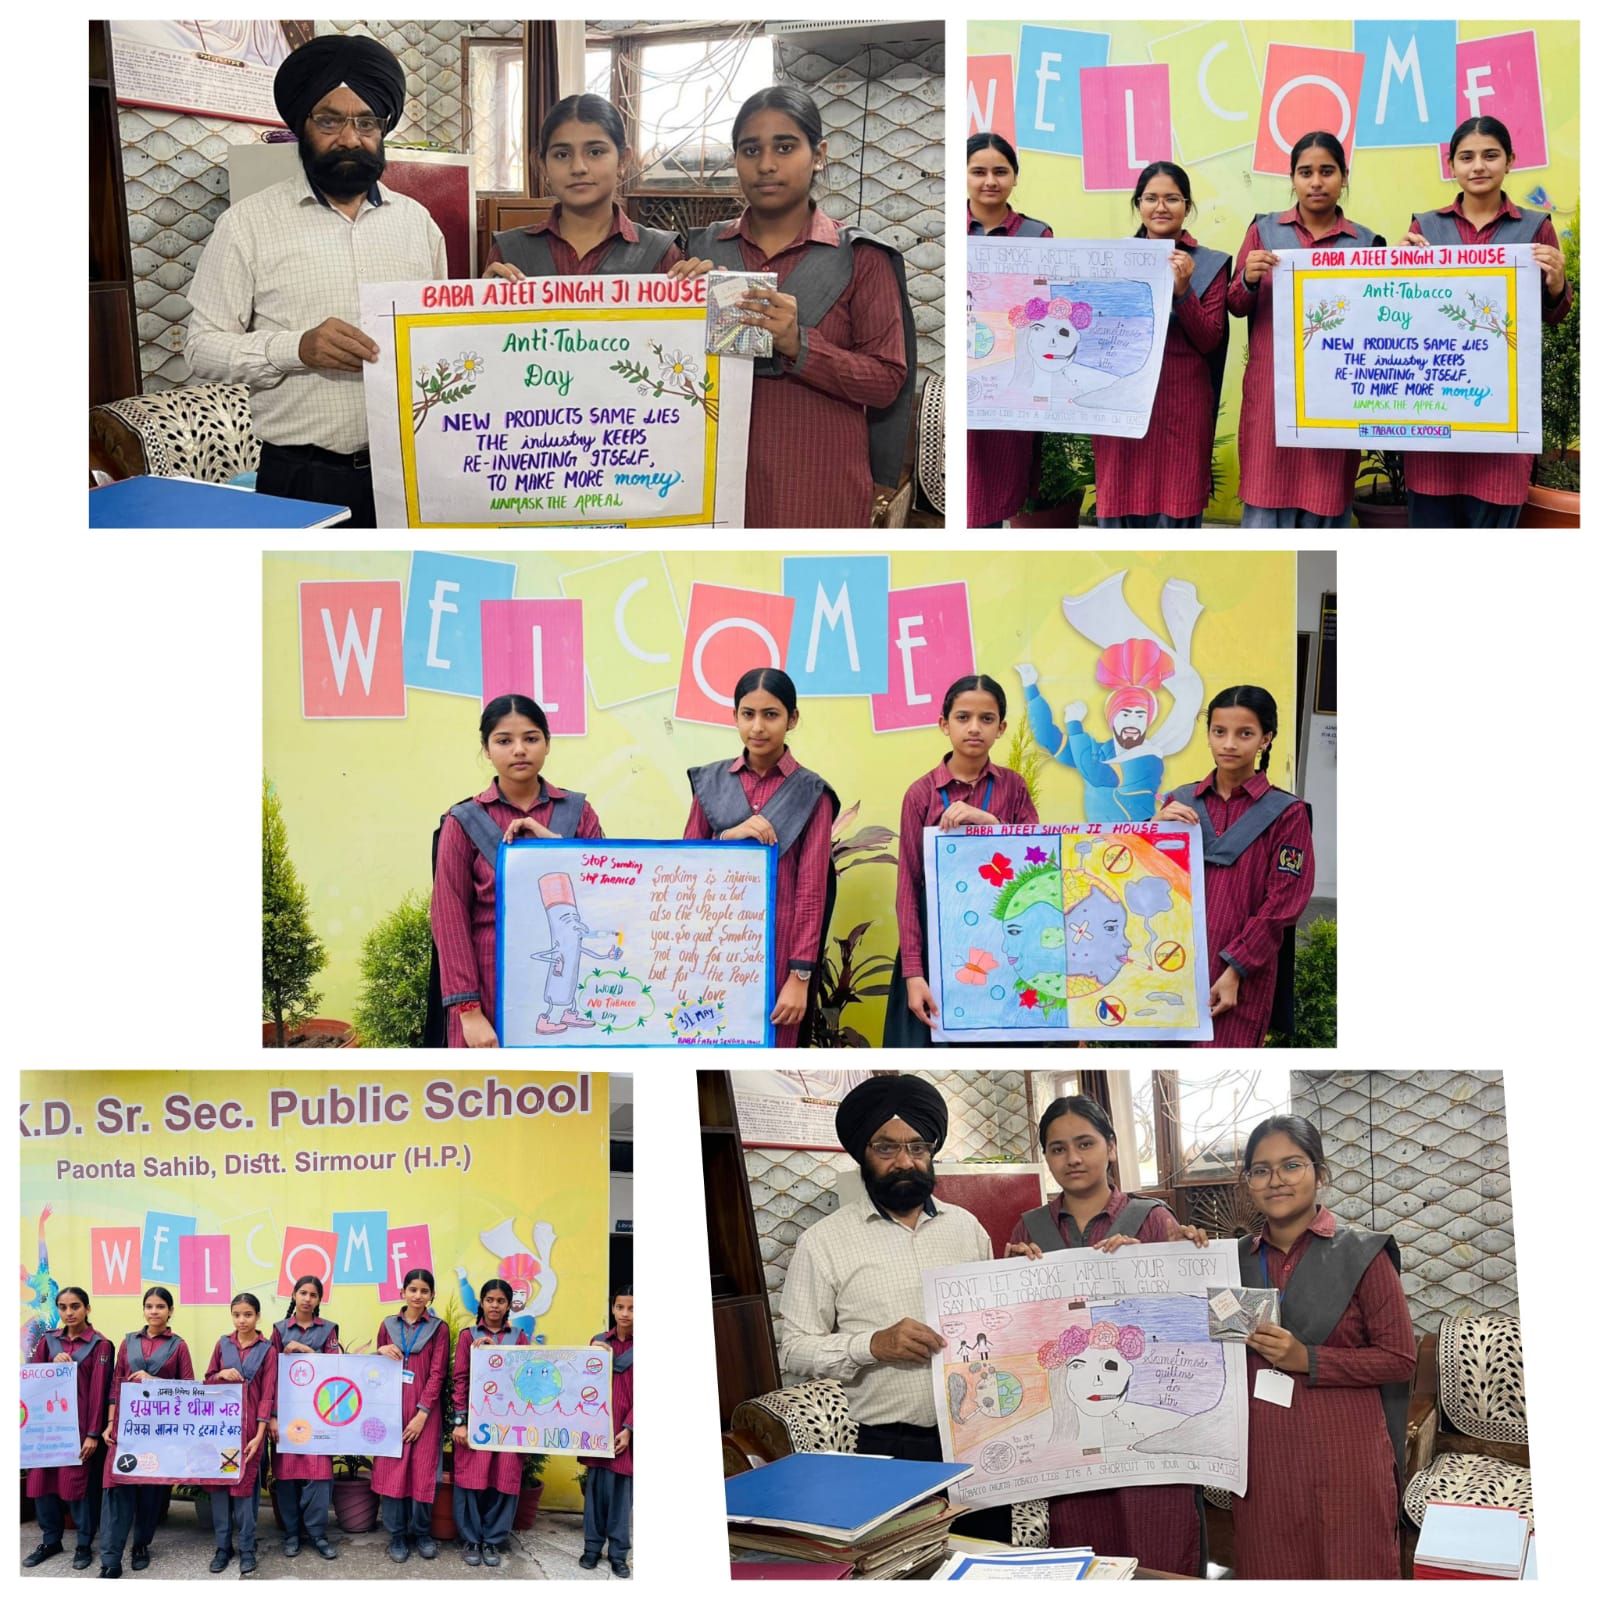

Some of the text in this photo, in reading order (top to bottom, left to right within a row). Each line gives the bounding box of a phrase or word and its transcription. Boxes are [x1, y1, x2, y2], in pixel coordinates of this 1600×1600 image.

[1040, 250, 1076, 265] WRITE
[1088, 251, 1113, 267] YOUR
[1123, 252, 1157, 267] STORY
[1312, 248, 1506, 266] BABA AJEET SINGH JI HOUSE
[422, 284, 474, 308] BABA
[483, 281, 537, 305] AJEET
[542, 279, 604, 304] SINGH
[611, 279, 630, 303] JI
[638, 279, 706, 303] HOUSE
[1377, 306, 1413, 330] Day
[1321, 337, 1488, 351] NEW PRODUCTS SAME LIES
[1344, 353, 1465, 370] THE industry KEEPS
[524, 363, 574, 396] Day
[1335, 367, 1416, 381] RE-INVENTING
[1352, 382, 1364, 396] TO
[1370, 382, 1399, 396] MAKE
[1405, 382, 1434, 396] MORE
[1353, 399, 1448, 414] UNMASK THE APPEAL
[441, 407, 681, 432] NEW PRODUCTS SAME LIES
[476, 429, 647, 452] THE industry KEEPS
[1372, 425, 1407, 435] TABACCO
[1411, 425, 1450, 436] EXPOSED
[463, 451, 577, 473] RE-INVENTING
[487, 474, 507, 491] TO
[515, 471, 555, 491] MAKE
[564, 470, 604, 488] MORE
[490, 493, 623, 514] UNMASK THE APPEAL
[321, 579, 925, 713] WELCOME
[965, 823, 1159, 835] BABA AJEET SINGH JI HOUSE
[652, 865, 698, 888] Smoking
[704, 868, 716, 884] is
[651, 885, 669, 902] not
[676, 888, 697, 910] only
[719, 890, 727, 901] u
[731, 885, 747, 901] but
[650, 905, 671, 922] also
[675, 904, 692, 921] the
[694, 926, 714, 950] quit
[654, 946, 671, 961] not
[679, 950, 699, 973] only
[700, 946, 721, 975] for
[648, 963, 667, 980] but
[671, 965, 689, 991] for
[707, 965, 724, 982] the
[595, 984, 624, 996] WORLD
[678, 985, 726, 1001] u love
[587, 998, 602, 1008] NO
[679, 1012, 694, 1030] 31
[100, 1098, 150, 1134] Sr.
[164, 1093, 254, 1132] Sec.
[270, 1084, 410, 1128] Public
[424, 1074, 591, 1118] School
[56, 1144, 472, 1180] Paonta Sahib, Distt. Sirmour (H.P.)
[100, 1222, 410, 1294] WELCOME
[988, 1273, 1012, 1292] LET
[1020, 1264, 1066, 1287] SMOKE
[1075, 1260, 1121, 1280] WRITE
[1131, 1258, 1165, 1278] YOUR
[1177, 1257, 1217, 1277] STORY
[943, 1279, 1170, 1315] SAY NO TO TOBACCO LIVE IN GLORY
[20, 1366, 73, 1379] BACCO DAY
[174, 1396, 182, 1416] है
[183, 1423, 195, 1436] पर
[473, 1423, 608, 1450] SAY TO NO DRUG
[1099, 1461, 1139, 1474] SHORTCUT
[1145, 1461, 1155, 1470] TO
